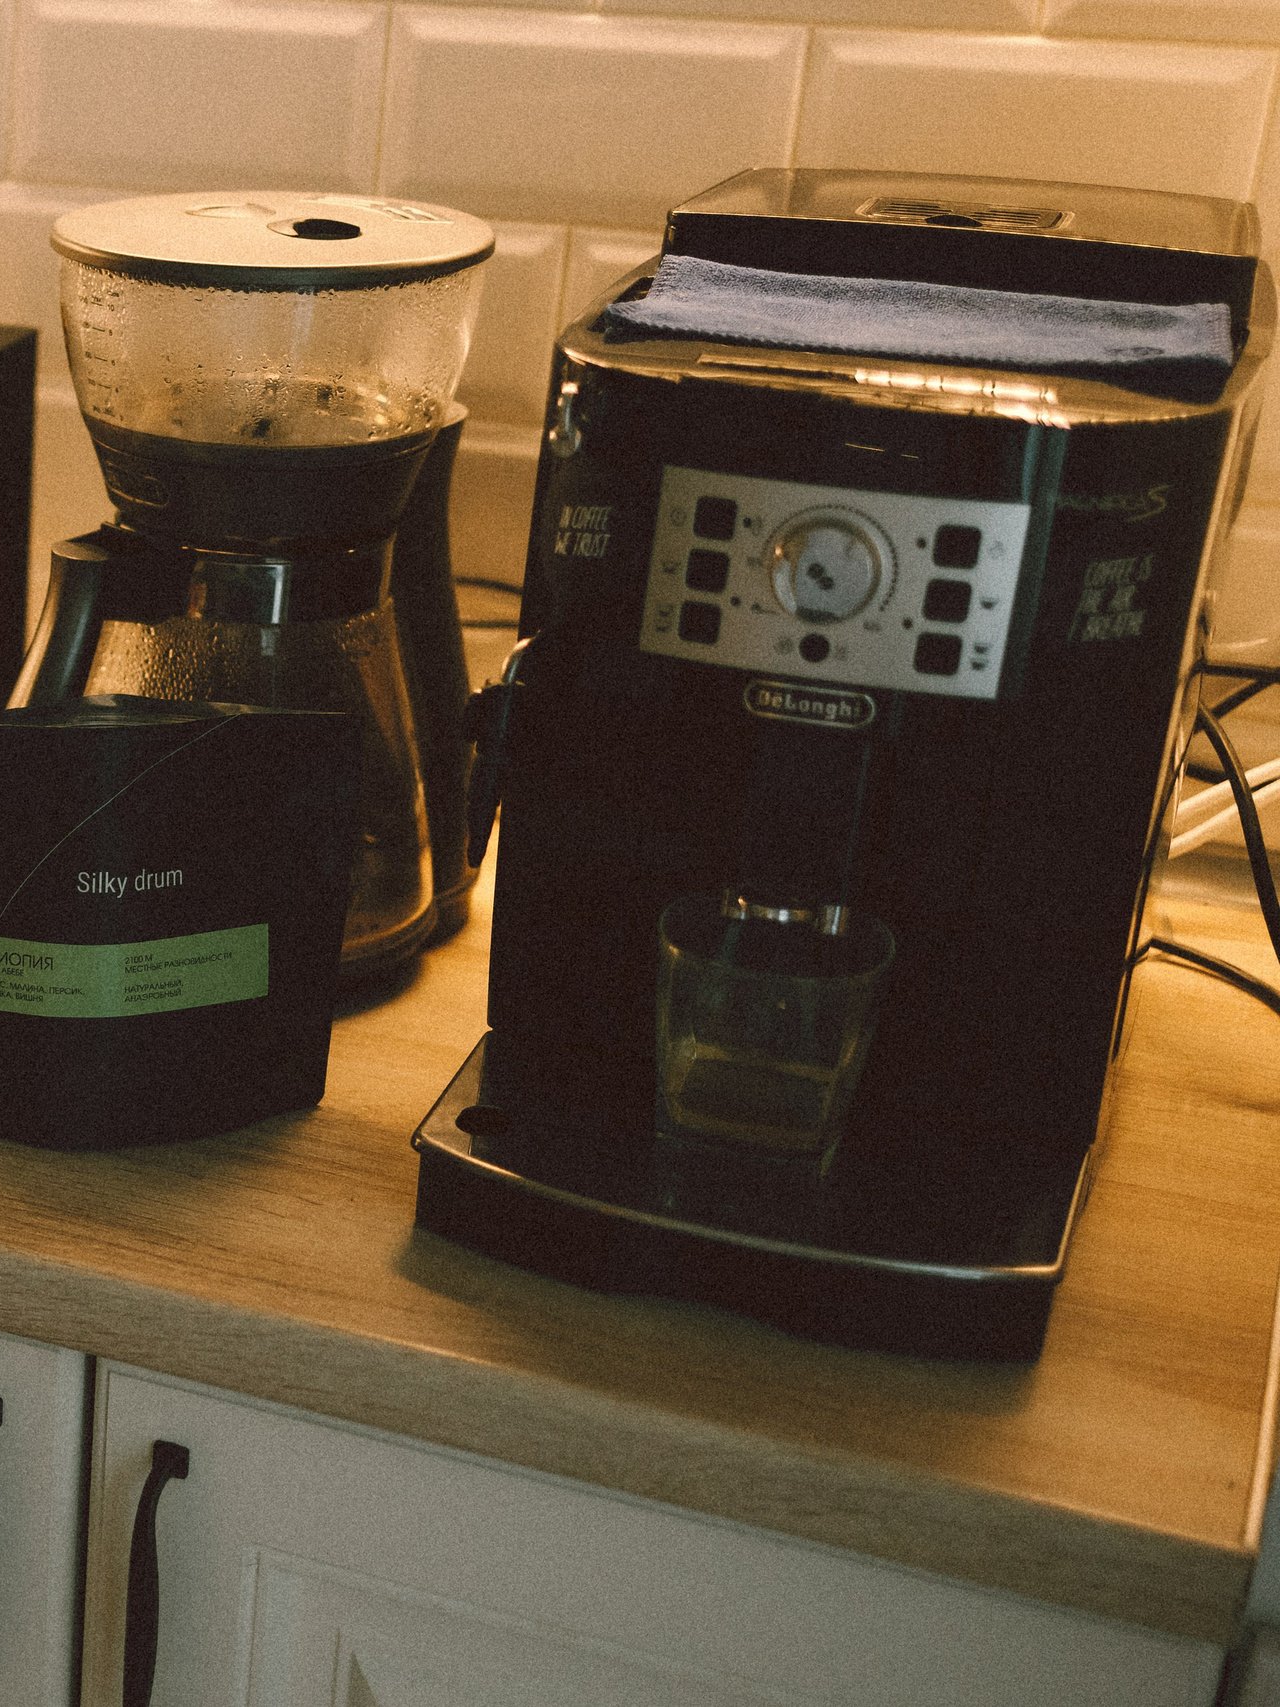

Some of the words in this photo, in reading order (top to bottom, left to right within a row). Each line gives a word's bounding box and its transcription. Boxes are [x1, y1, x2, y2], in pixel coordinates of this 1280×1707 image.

[77, 871, 128, 899] Silky
[134, 868, 183, 892] drum
[124, 955, 144, 964] 2100
[124, 962, 162, 974] МЕСТНЫЕ
[164, 952, 233, 968] РАЗНОВИДНОСТИ
[15, 992, 44, 1003] ВИШНЯ
[124, 988, 182, 1003] АНАЭРОБНЫЙ
